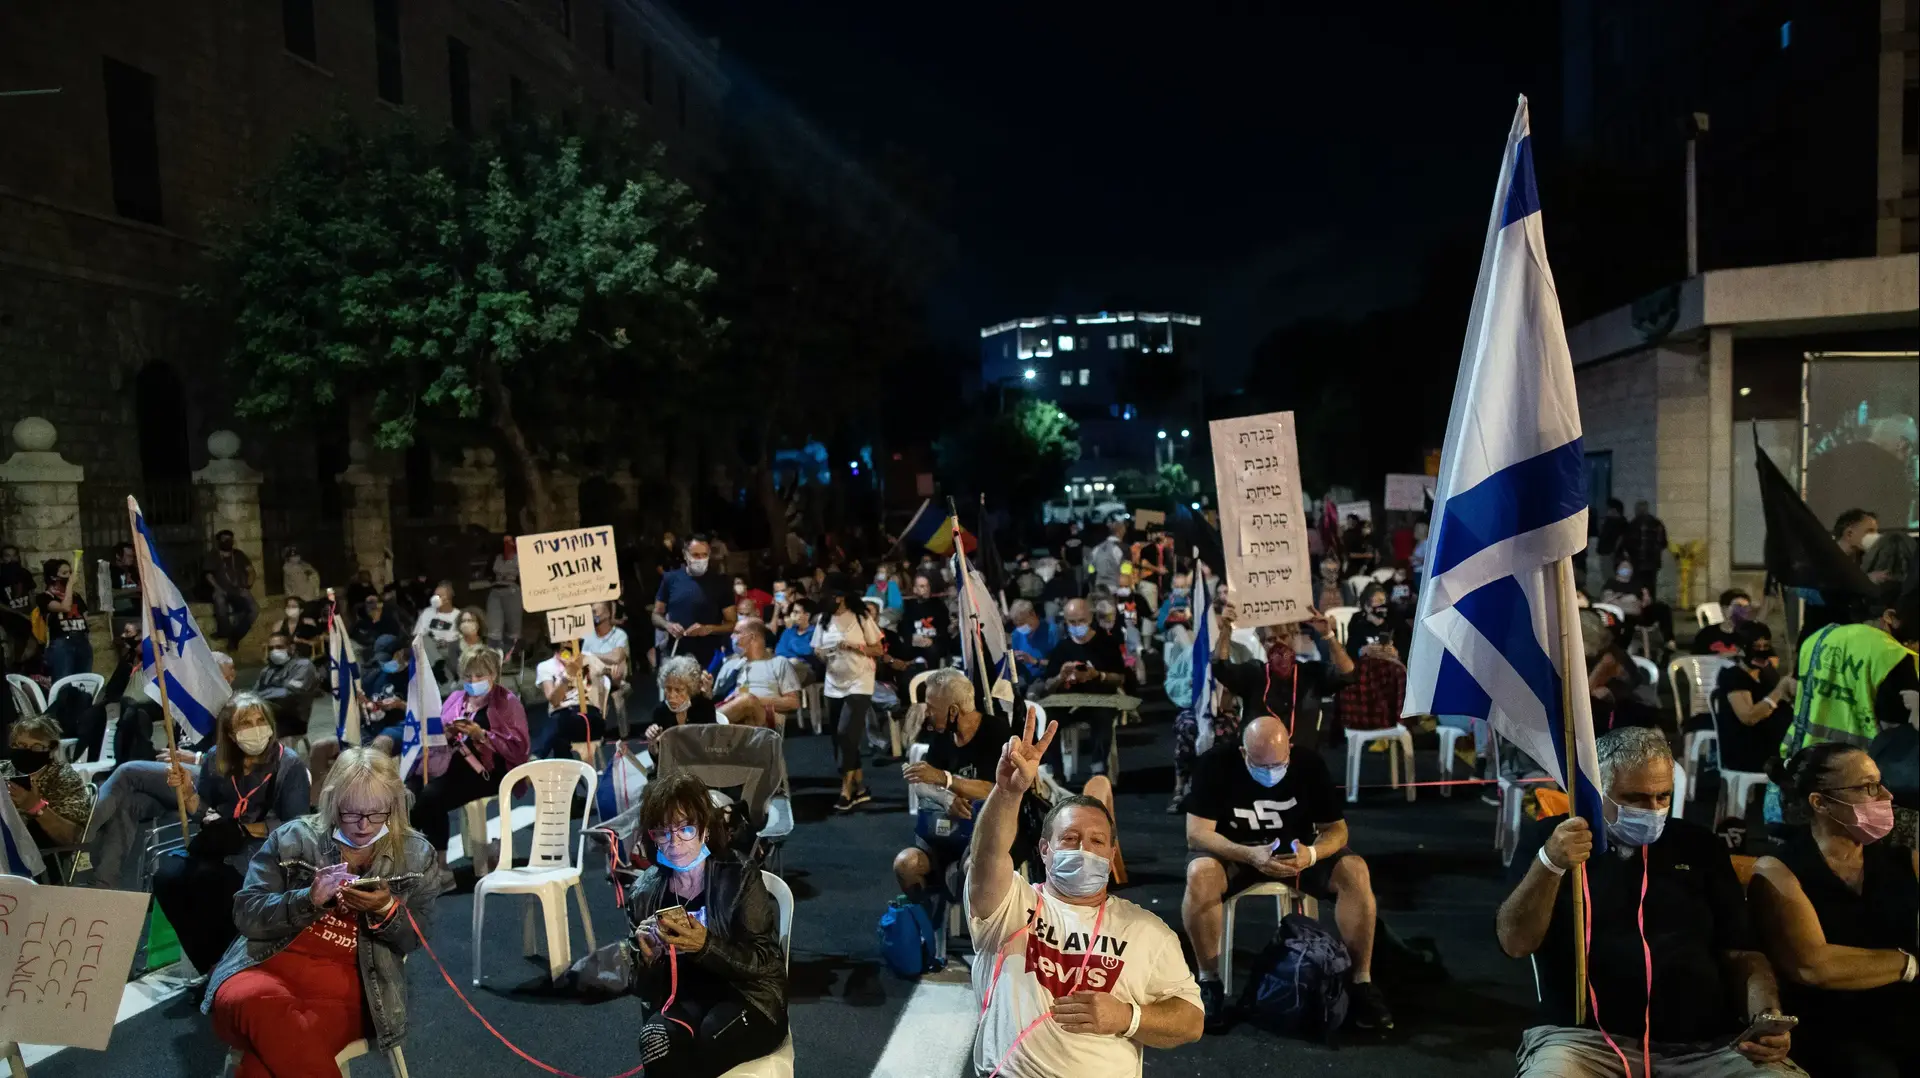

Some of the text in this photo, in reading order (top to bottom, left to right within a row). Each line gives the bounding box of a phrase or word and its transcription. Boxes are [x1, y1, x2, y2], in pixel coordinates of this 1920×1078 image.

[547, 555, 602, 582] אהובתי
[551, 614, 586, 636] שקרן
[36, 917, 77, 1004] כלכלי
[1063, 932, 1128, 957] AVIV
[65, 919, 109, 1012] חברתי
[1031, 947, 1108, 988] evi's
